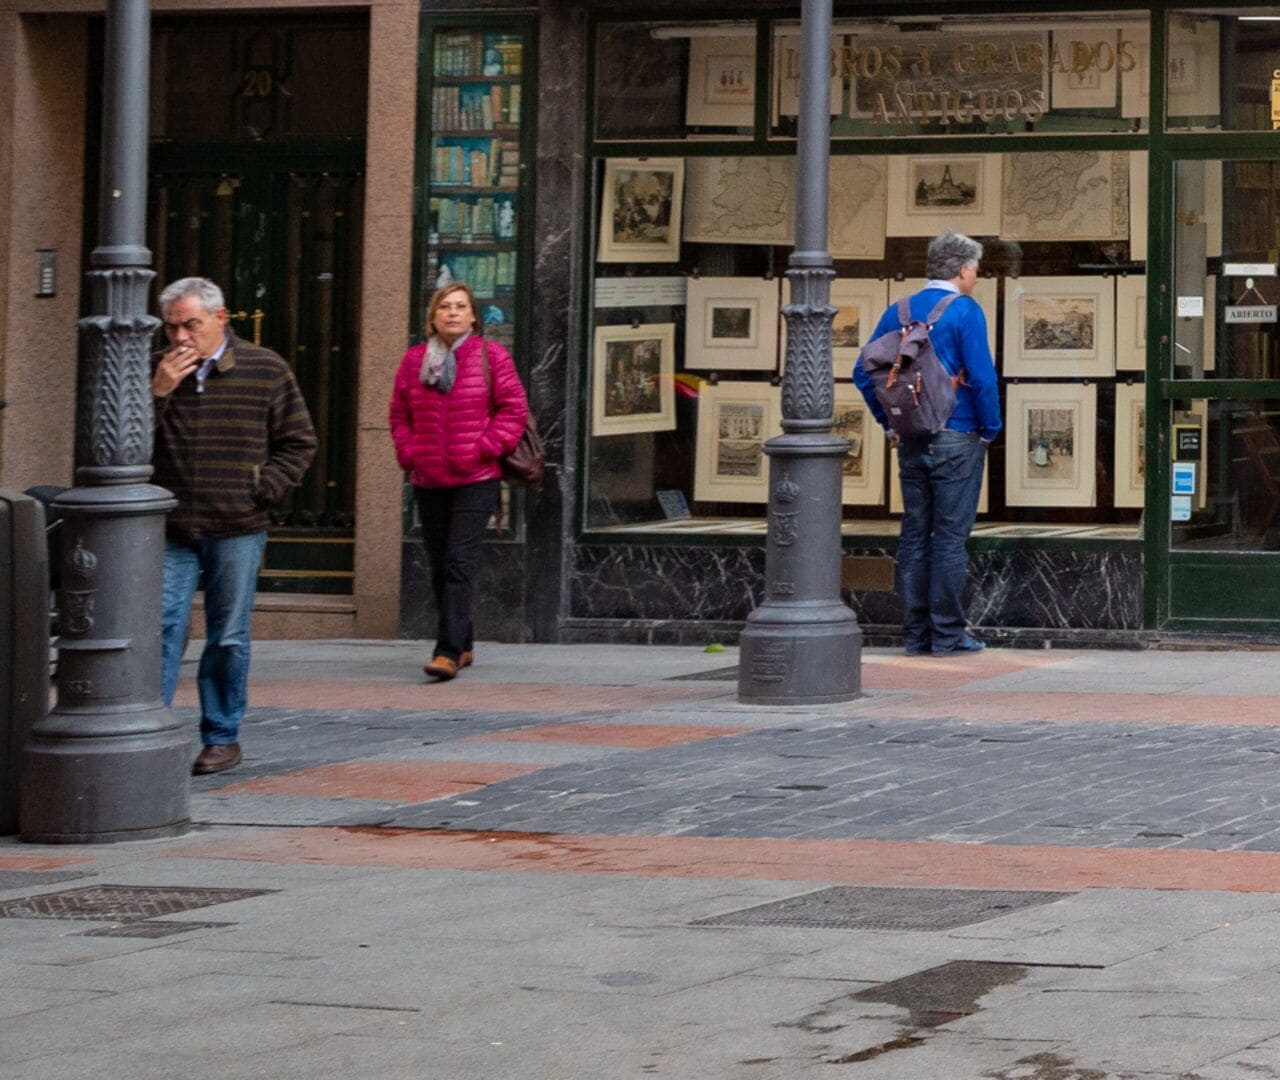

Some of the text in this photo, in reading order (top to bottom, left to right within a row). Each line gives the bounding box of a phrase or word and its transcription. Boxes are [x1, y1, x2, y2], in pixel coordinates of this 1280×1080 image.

[783, 45, 901, 78] LROS
[953, 40, 1137, 73] GRABADOS
[870, 89, 1046, 125] ANTIGUOS
[1230, 309, 1273, 319] ABIERTO
